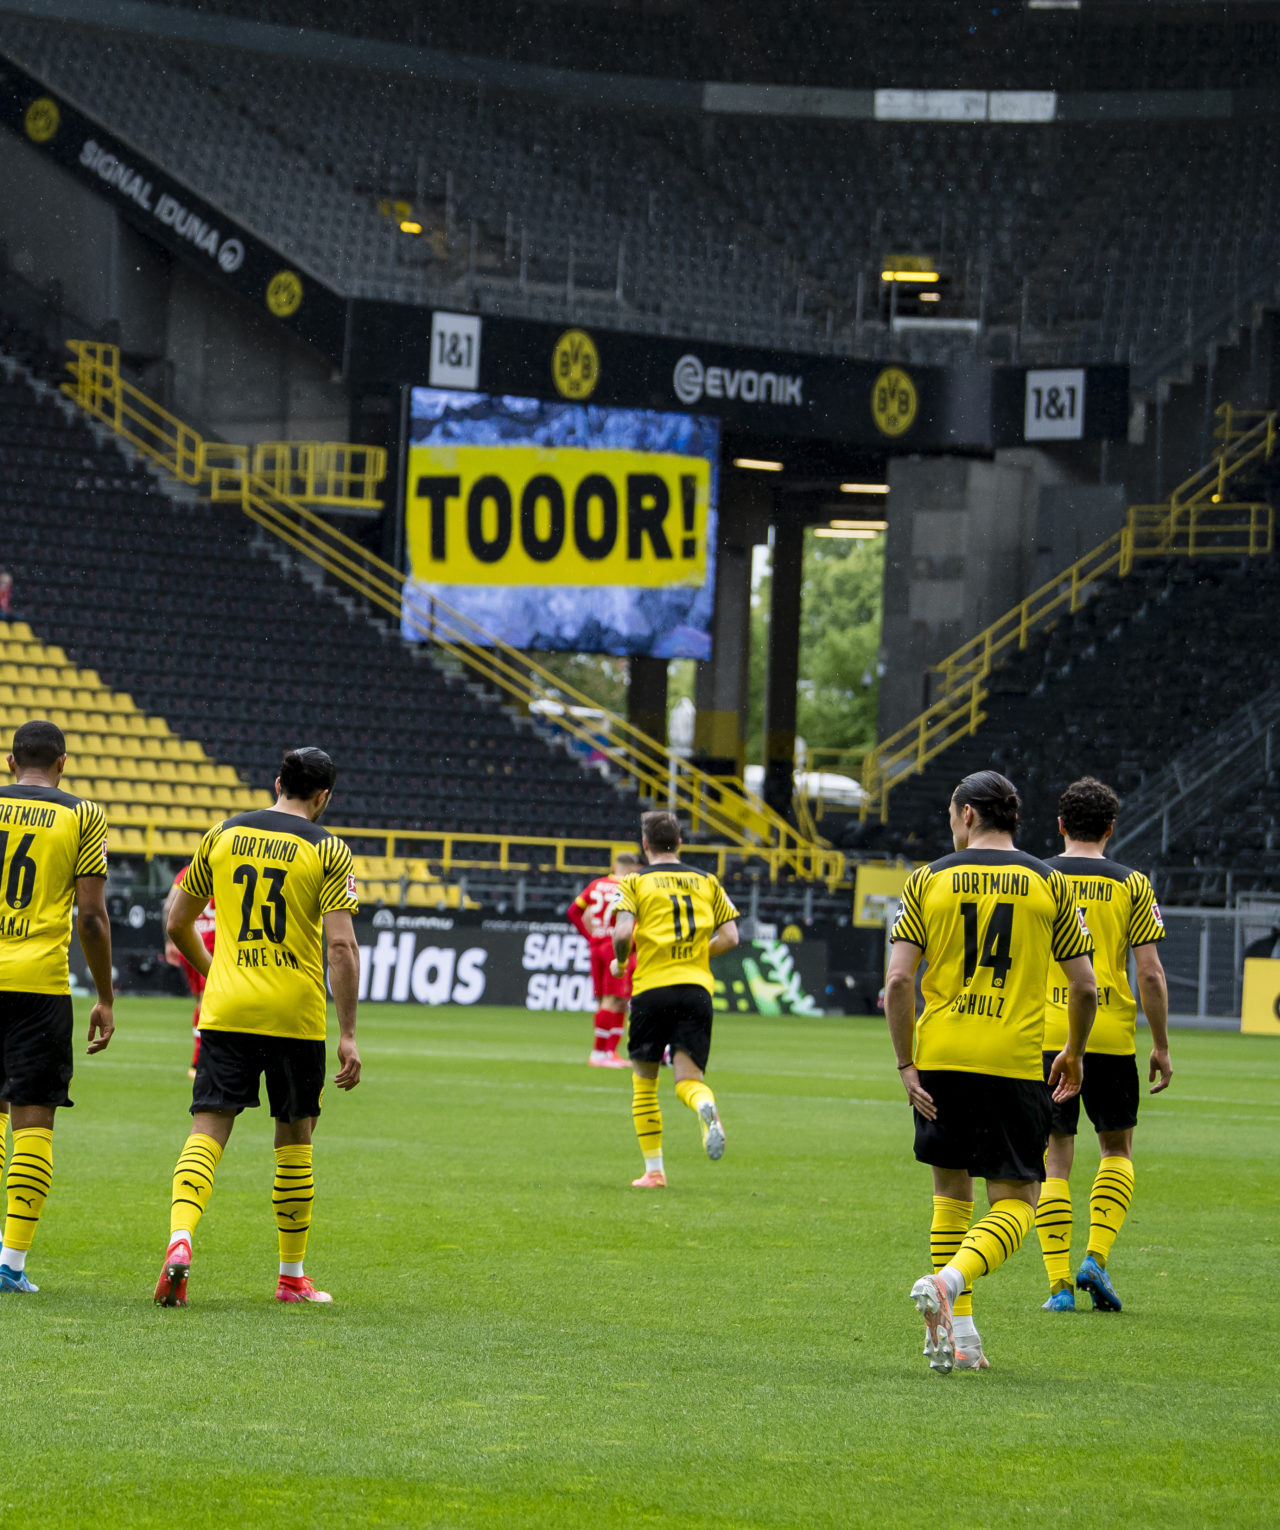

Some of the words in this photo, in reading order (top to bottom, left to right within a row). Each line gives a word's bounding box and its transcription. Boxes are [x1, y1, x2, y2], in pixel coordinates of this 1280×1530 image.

[79, 139, 153, 210] SIGNAL
[154, 193, 221, 257] IDUNA
[437, 331, 473, 369] 1&1
[705, 366, 803, 405] EVONIK
[1032, 386, 1077, 420] 1&1
[415, 472, 698, 564] TOOOR!
[231, 834, 299, 863] DORTMUND
[653, 876, 700, 890] DORTMUND
[951, 872, 1030, 897] DORTMUND
[233, 864, 289, 945] 23
[589, 889, 618, 927] 27
[669, 894, 697, 943] 11
[236, 947, 269, 968] EMRE
[274, 948, 300, 970] CAN
[521, 932, 591, 972] SAFE
[959, 902, 1015, 989] 14
[950, 994, 1006, 1019] SCHULZ
